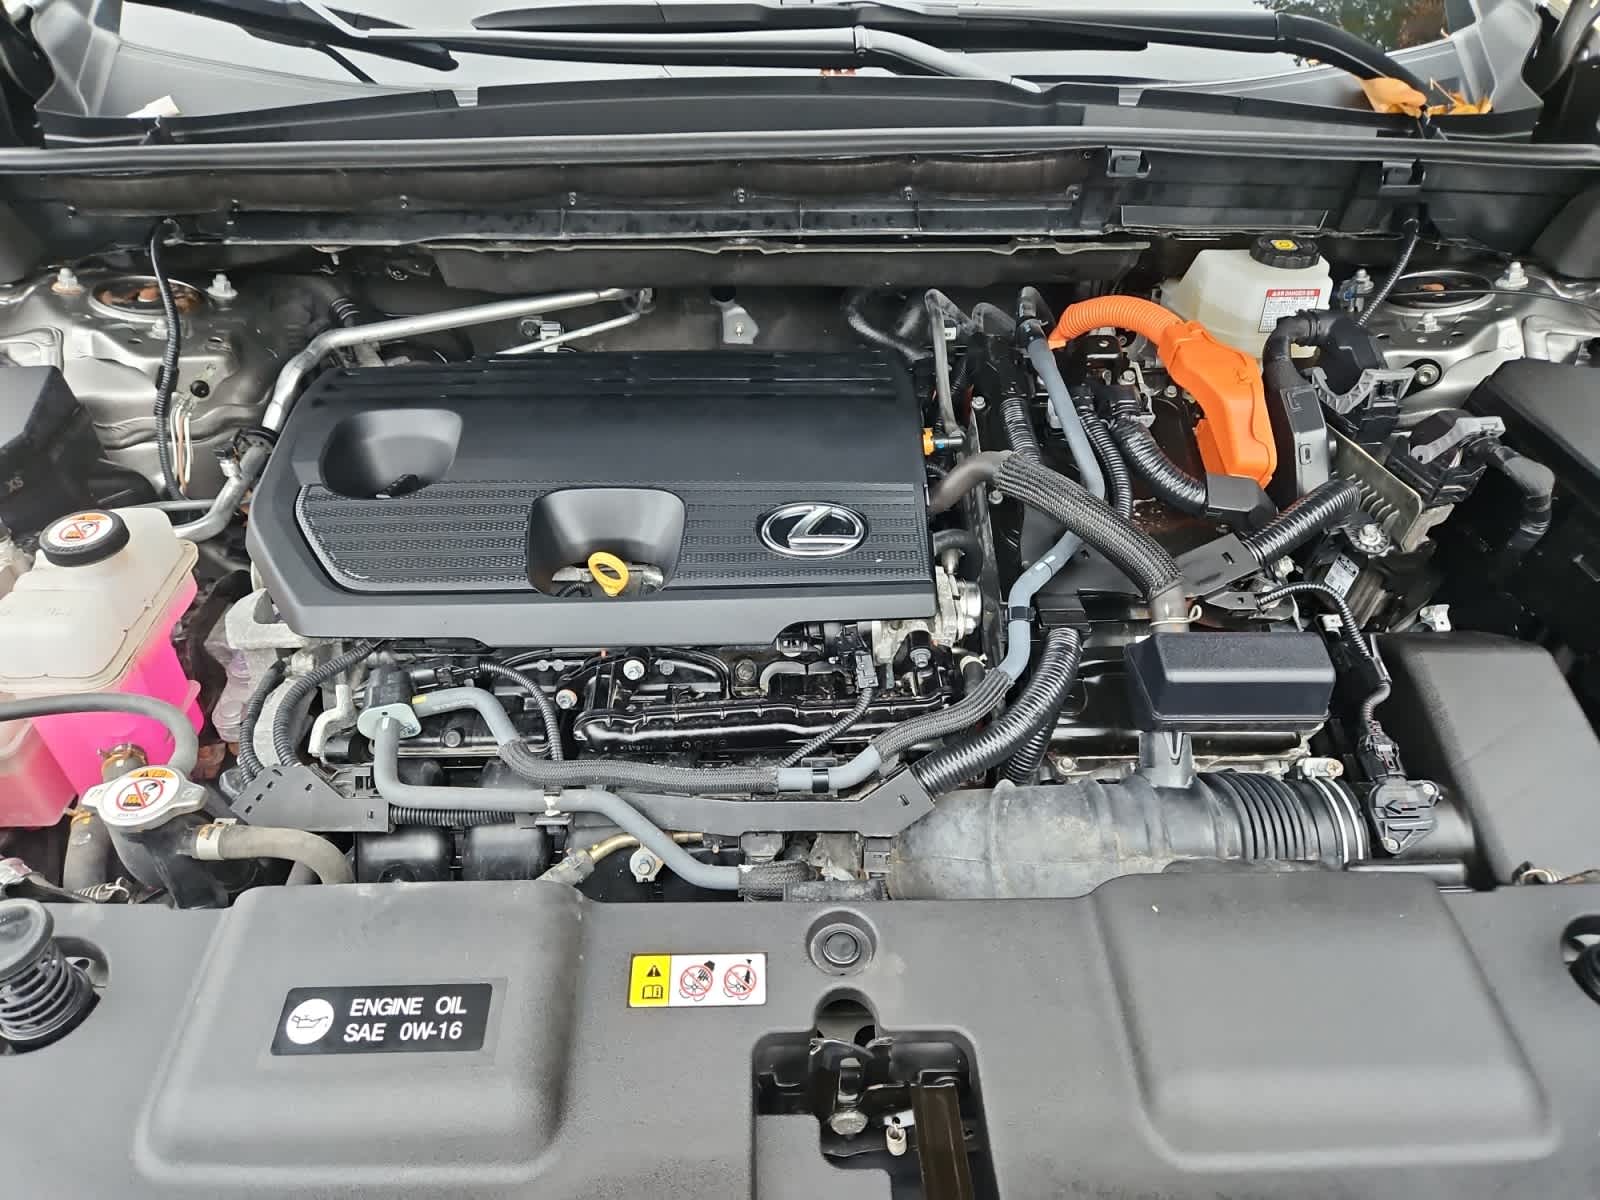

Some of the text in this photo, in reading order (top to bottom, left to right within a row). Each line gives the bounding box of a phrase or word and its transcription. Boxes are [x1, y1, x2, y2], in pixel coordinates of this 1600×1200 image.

[350, 995, 467, 1017] ENGINE OIL
[343, 1020, 463, 1043] SAE 0W-16
